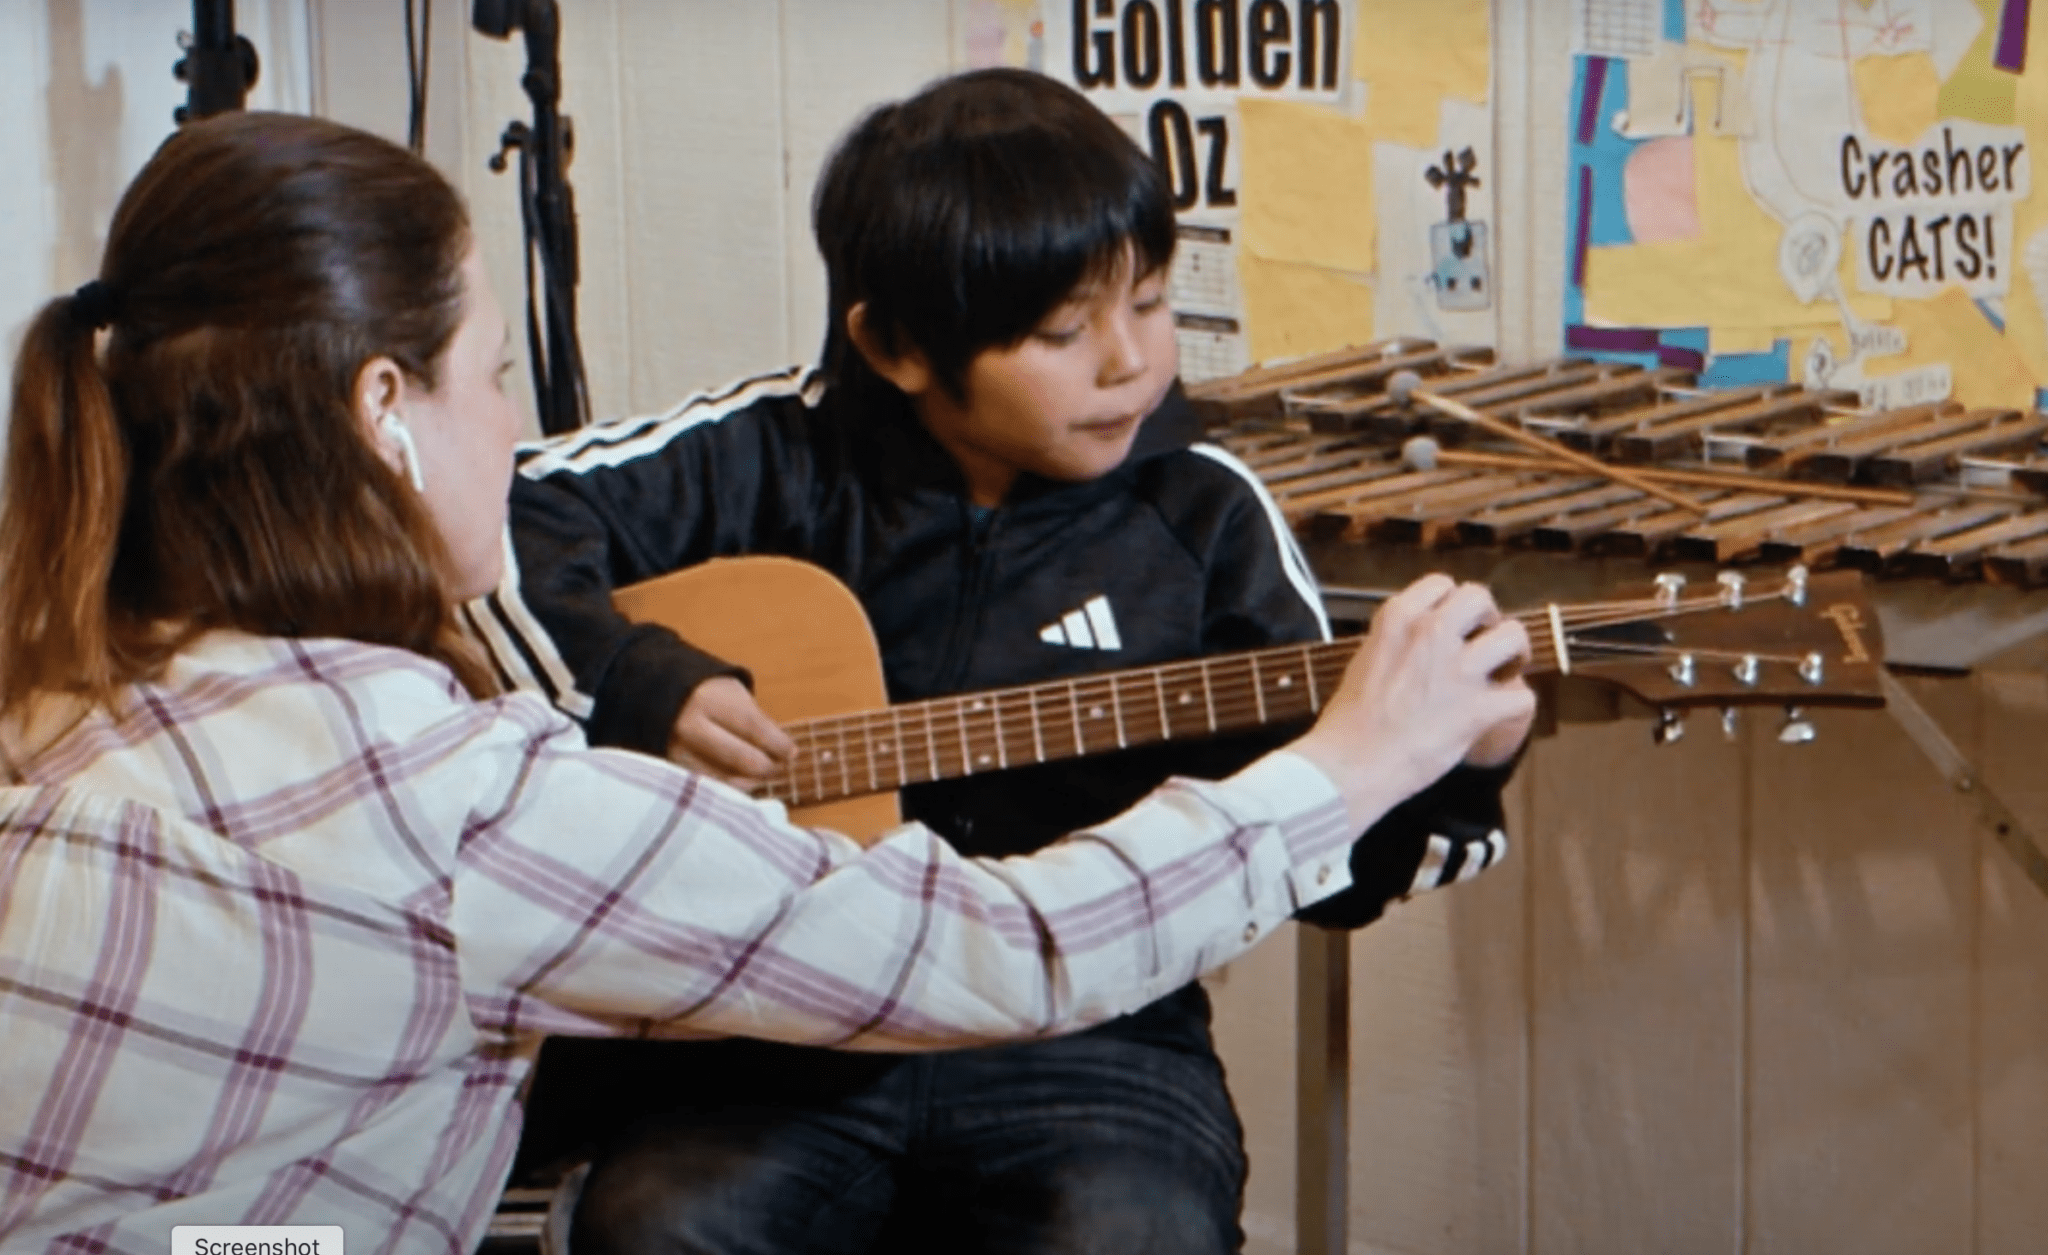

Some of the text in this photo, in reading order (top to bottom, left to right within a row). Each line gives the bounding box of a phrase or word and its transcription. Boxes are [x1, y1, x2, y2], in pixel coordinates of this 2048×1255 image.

[1072, 0, 1341, 91] Golden
[1149, 98, 1238, 213] Oz
[1841, 127, 2025, 199] Crasher
[1868, 213, 1997, 283] CATS!
